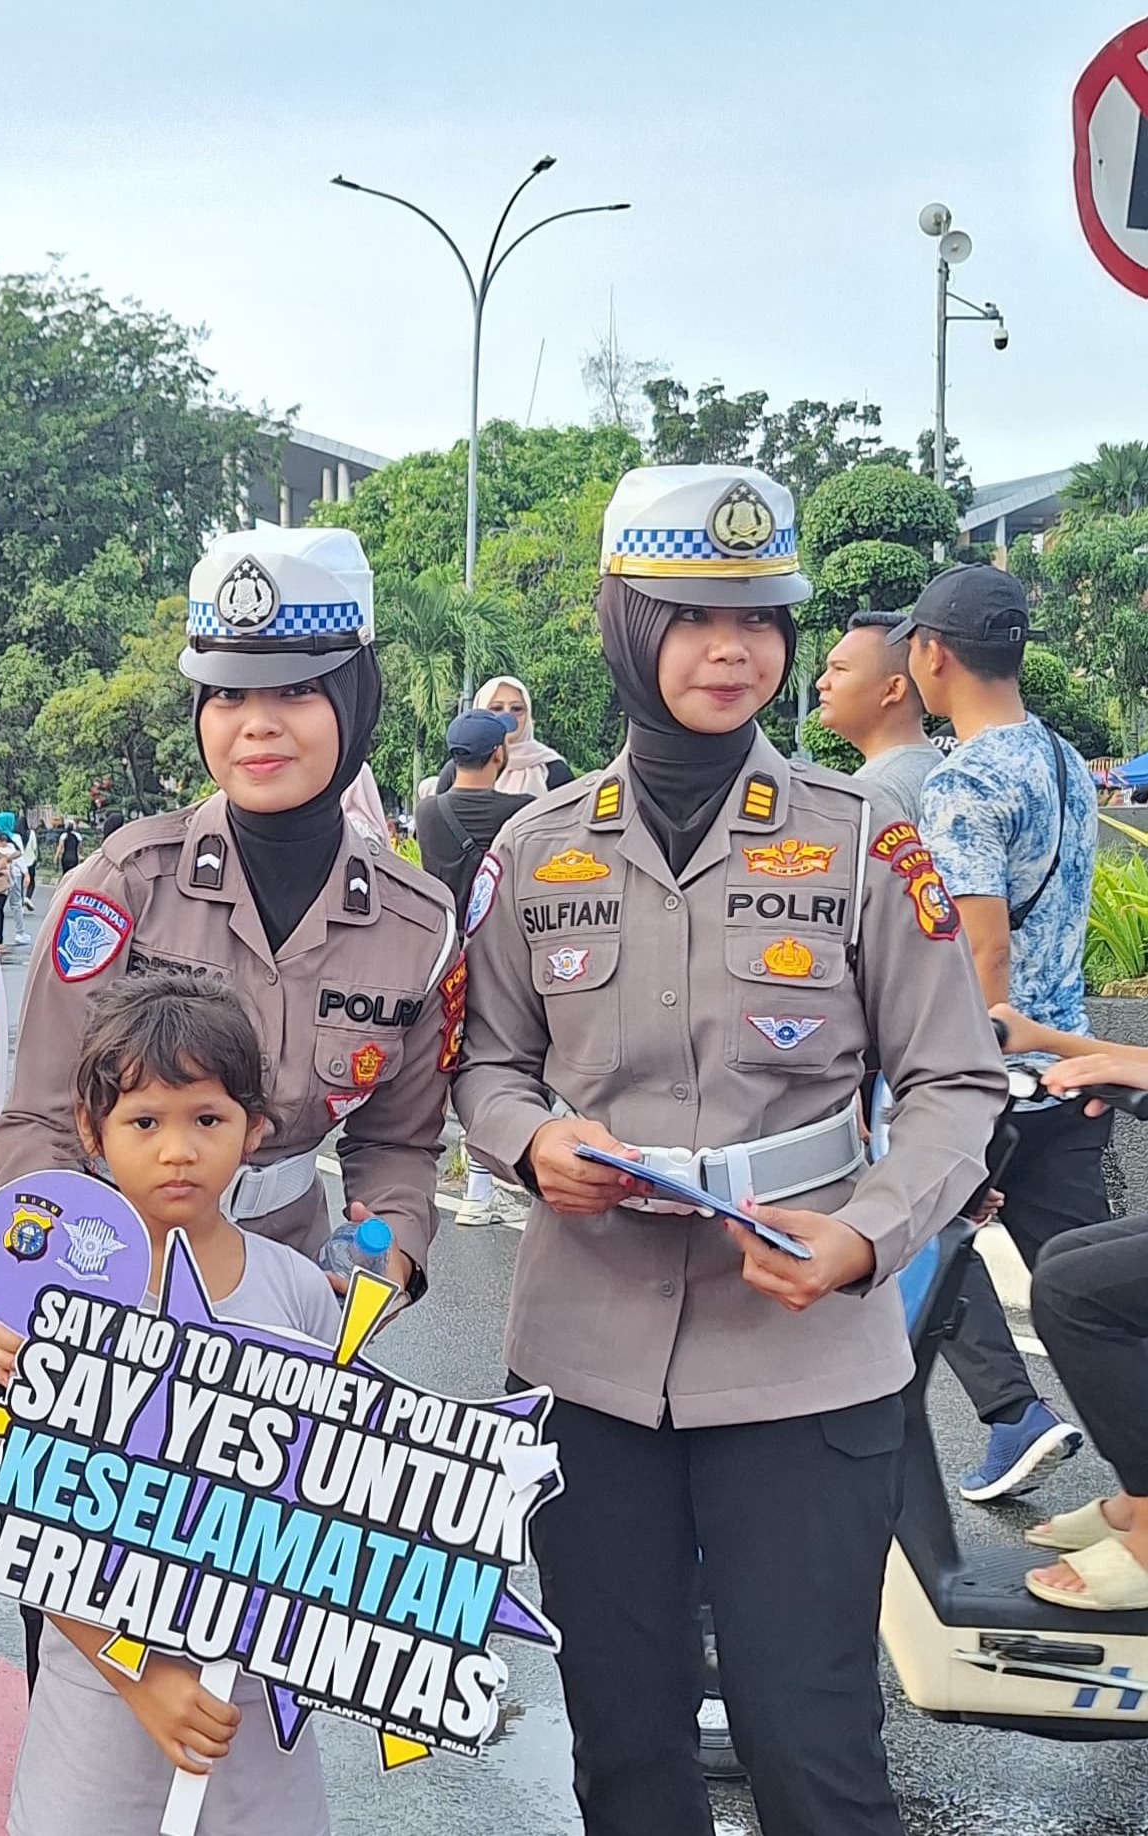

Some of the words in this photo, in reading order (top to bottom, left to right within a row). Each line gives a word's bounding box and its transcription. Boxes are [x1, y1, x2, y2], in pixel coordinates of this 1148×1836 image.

[93, 898, 127, 929] LINTAS
[523, 900, 620, 934] SULFIANI
[727, 893, 847, 927] POLRI
[34, 1290, 118, 1352] SAY
[118, 1312, 178, 1369] NO
[179, 1327, 235, 1382] TO
[233, 1346, 383, 1426] MONEY
[11, 1345, 157, 1448] SAY
[164, 1381, 298, 1488] YES
[302, 1423, 543, 1563] UNTUK
[251, 1595, 500, 1739] LINTAS
[297, 1695, 382, 1728] DITLANTAS
[385, 1722, 436, 1745] POLDA
[440, 1738, 477, 1756] RIAU
